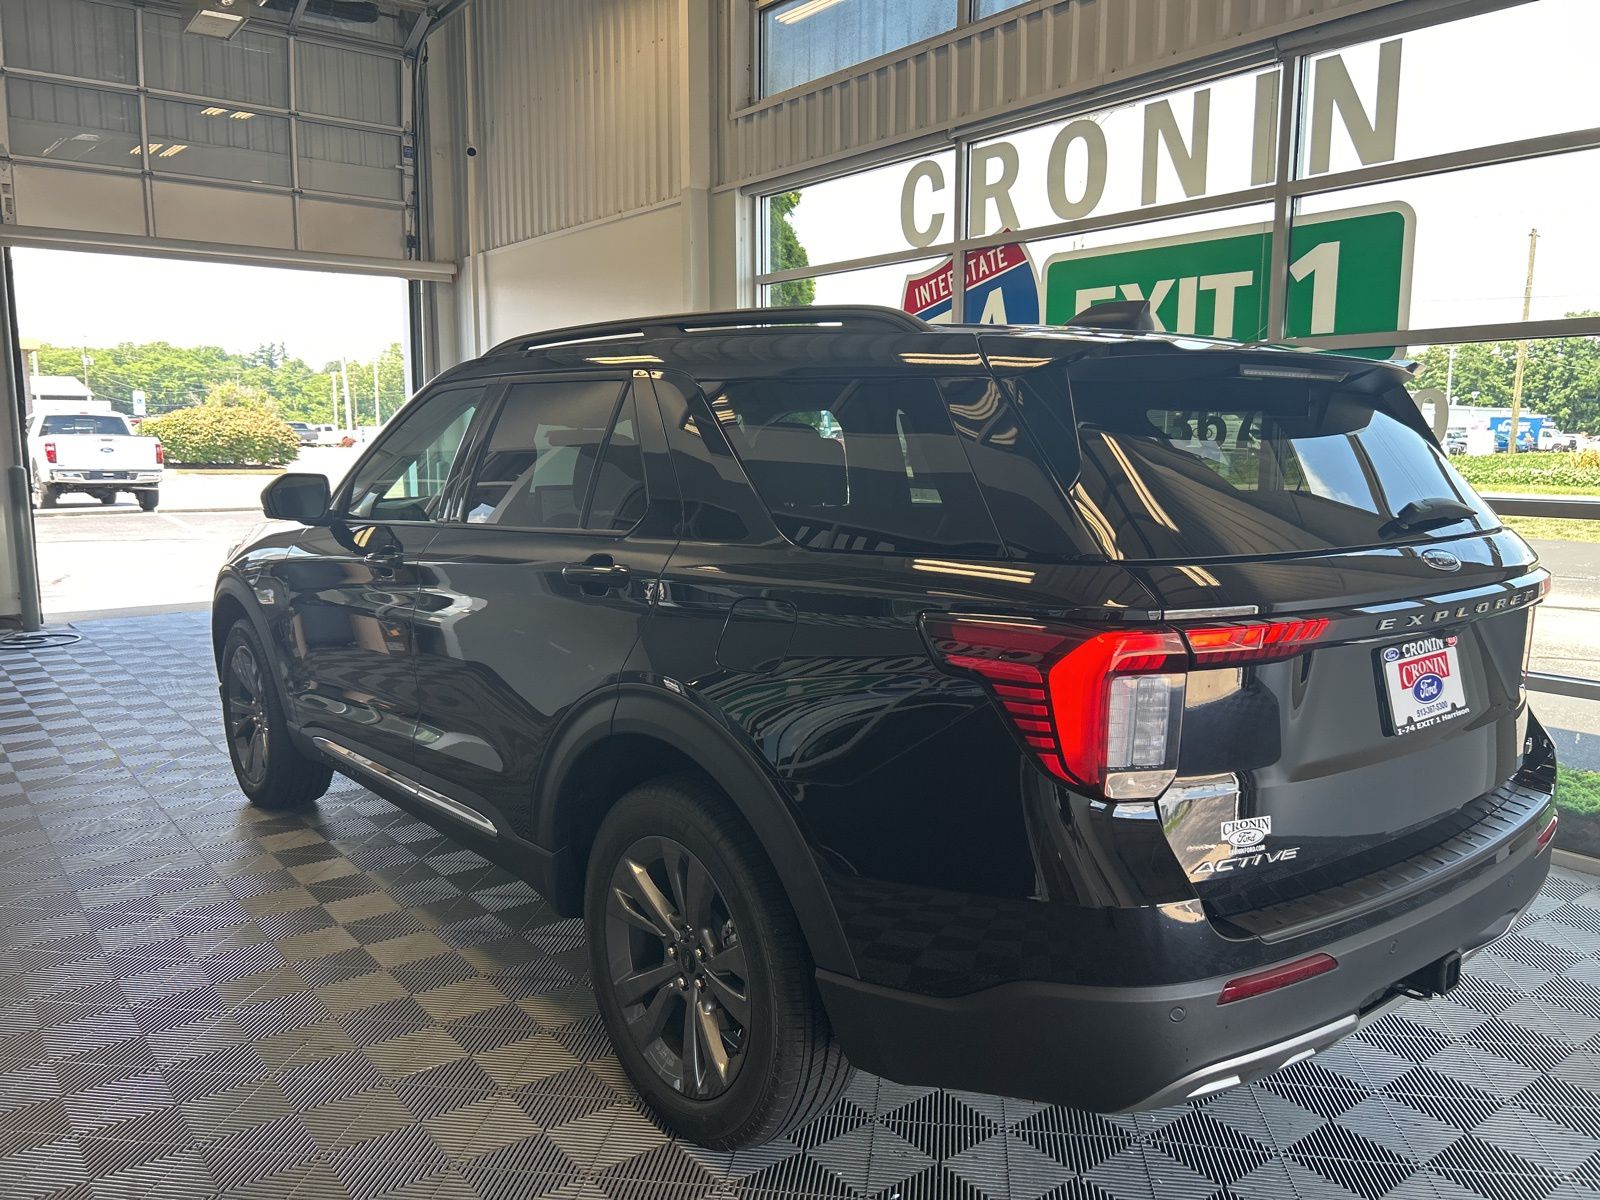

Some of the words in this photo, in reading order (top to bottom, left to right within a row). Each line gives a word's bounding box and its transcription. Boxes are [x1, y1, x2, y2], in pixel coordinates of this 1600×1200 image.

[900, 38, 1403, 248] CRONIN
[1289, 241, 1340, 334] 1
[1378, 590, 1534, 631] EXPLORER
[1402, 638, 1444, 658] CRONIN
[1402, 655, 1448, 687] CRONIN
[1420, 678, 1438, 698] Ford
[1397, 723, 1416, 735] I-74
[1416, 717, 1434, 729] EXIT
[1442, 708, 1470, 721] Harrison
[1416, 701, 1448, 718] 513-367-5300
[1223, 817, 1269, 835] CRONIN
[1237, 831, 1256, 843] Ford
[1190, 847, 1300, 874] ACTIVE
